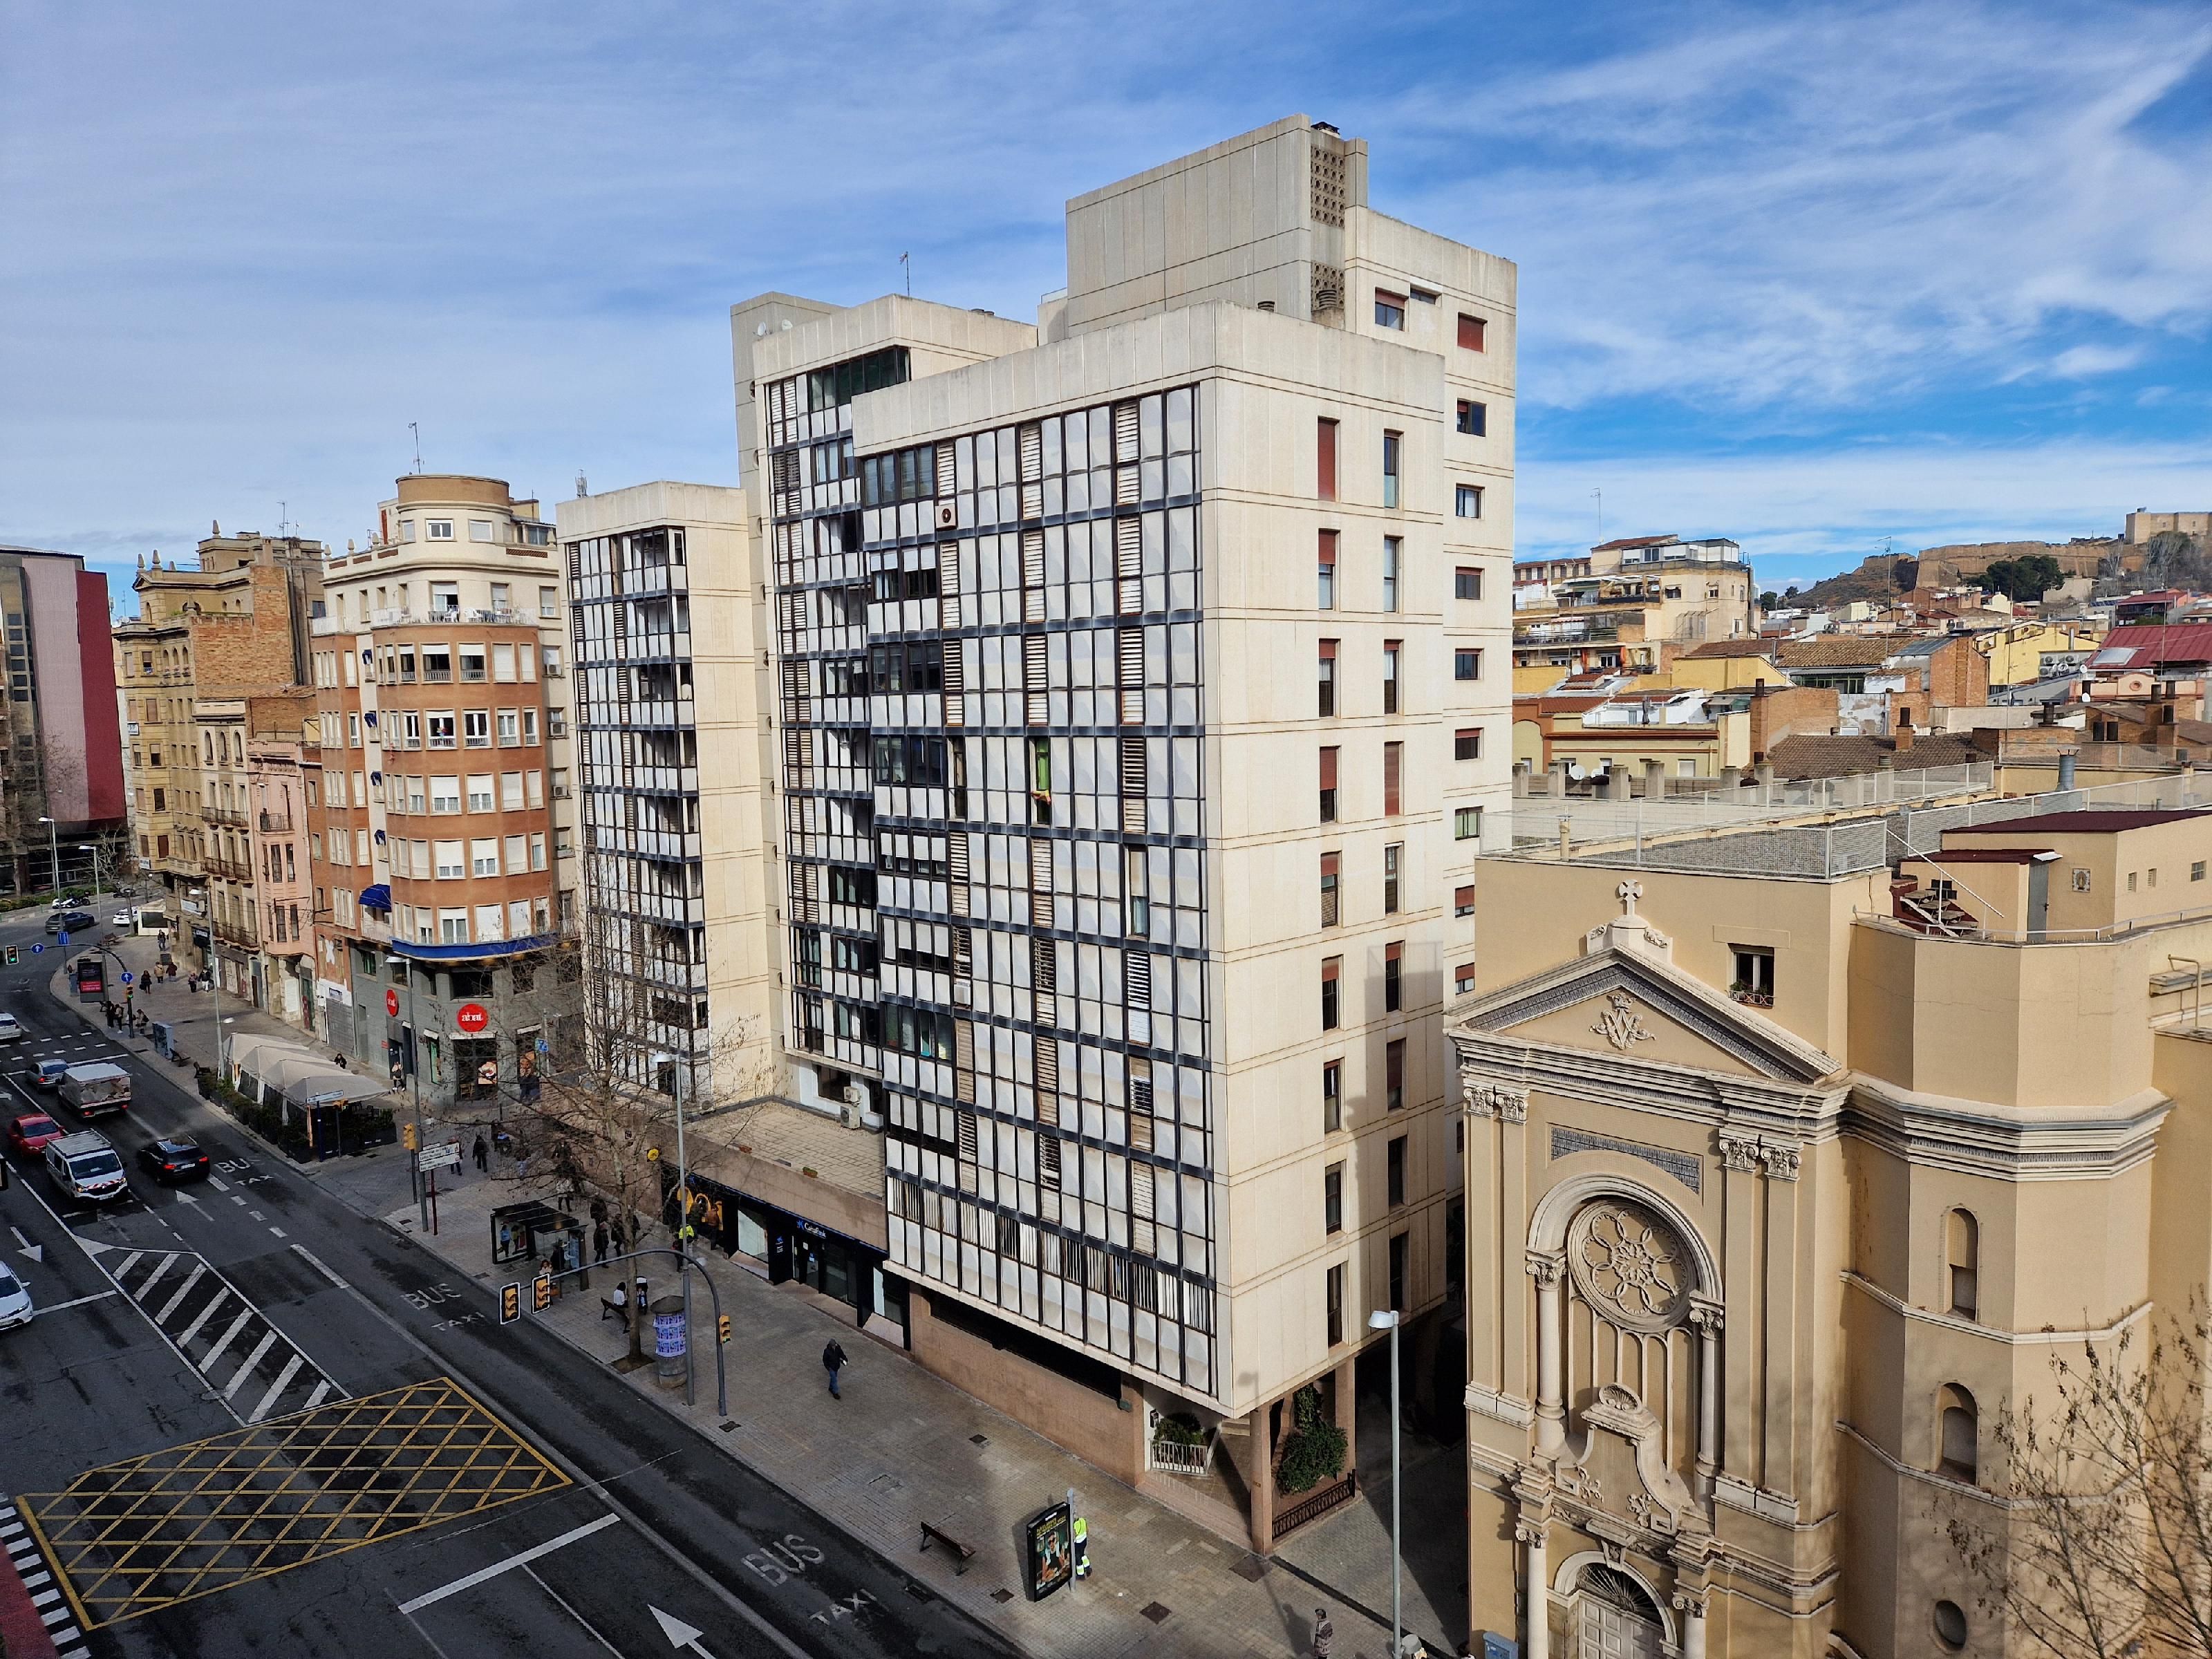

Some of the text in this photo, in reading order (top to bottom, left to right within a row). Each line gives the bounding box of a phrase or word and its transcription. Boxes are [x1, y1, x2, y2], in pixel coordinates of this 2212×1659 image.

[400, 1283, 462, 1310] BUS
[741, 1534, 825, 1587] BUS
[809, 1588, 878, 1625] TAXI
